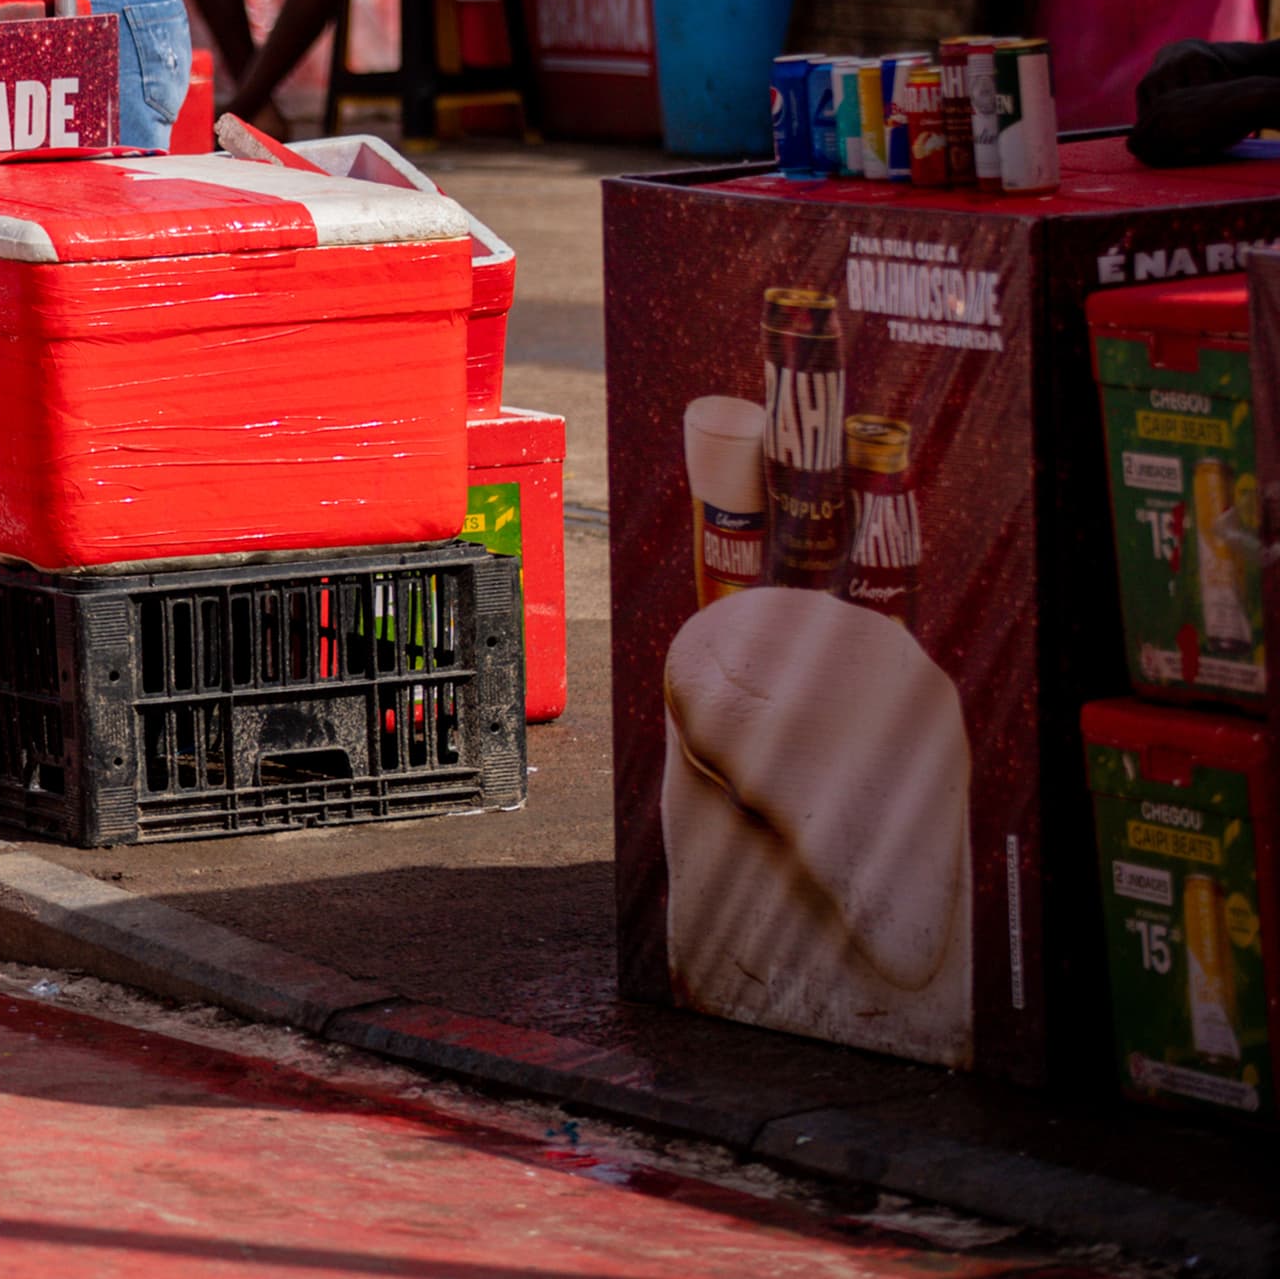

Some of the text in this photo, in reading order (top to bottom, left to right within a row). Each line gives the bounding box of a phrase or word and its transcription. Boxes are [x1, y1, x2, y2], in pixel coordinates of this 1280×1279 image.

[1097, 245, 1125, 284] É
[1134, 247, 1198, 280] NA
[1150, 388, 1211, 415] CHEGOU
[1141, 800, 1203, 831] CHEGOU
[1136, 920, 1172, 974] 15
